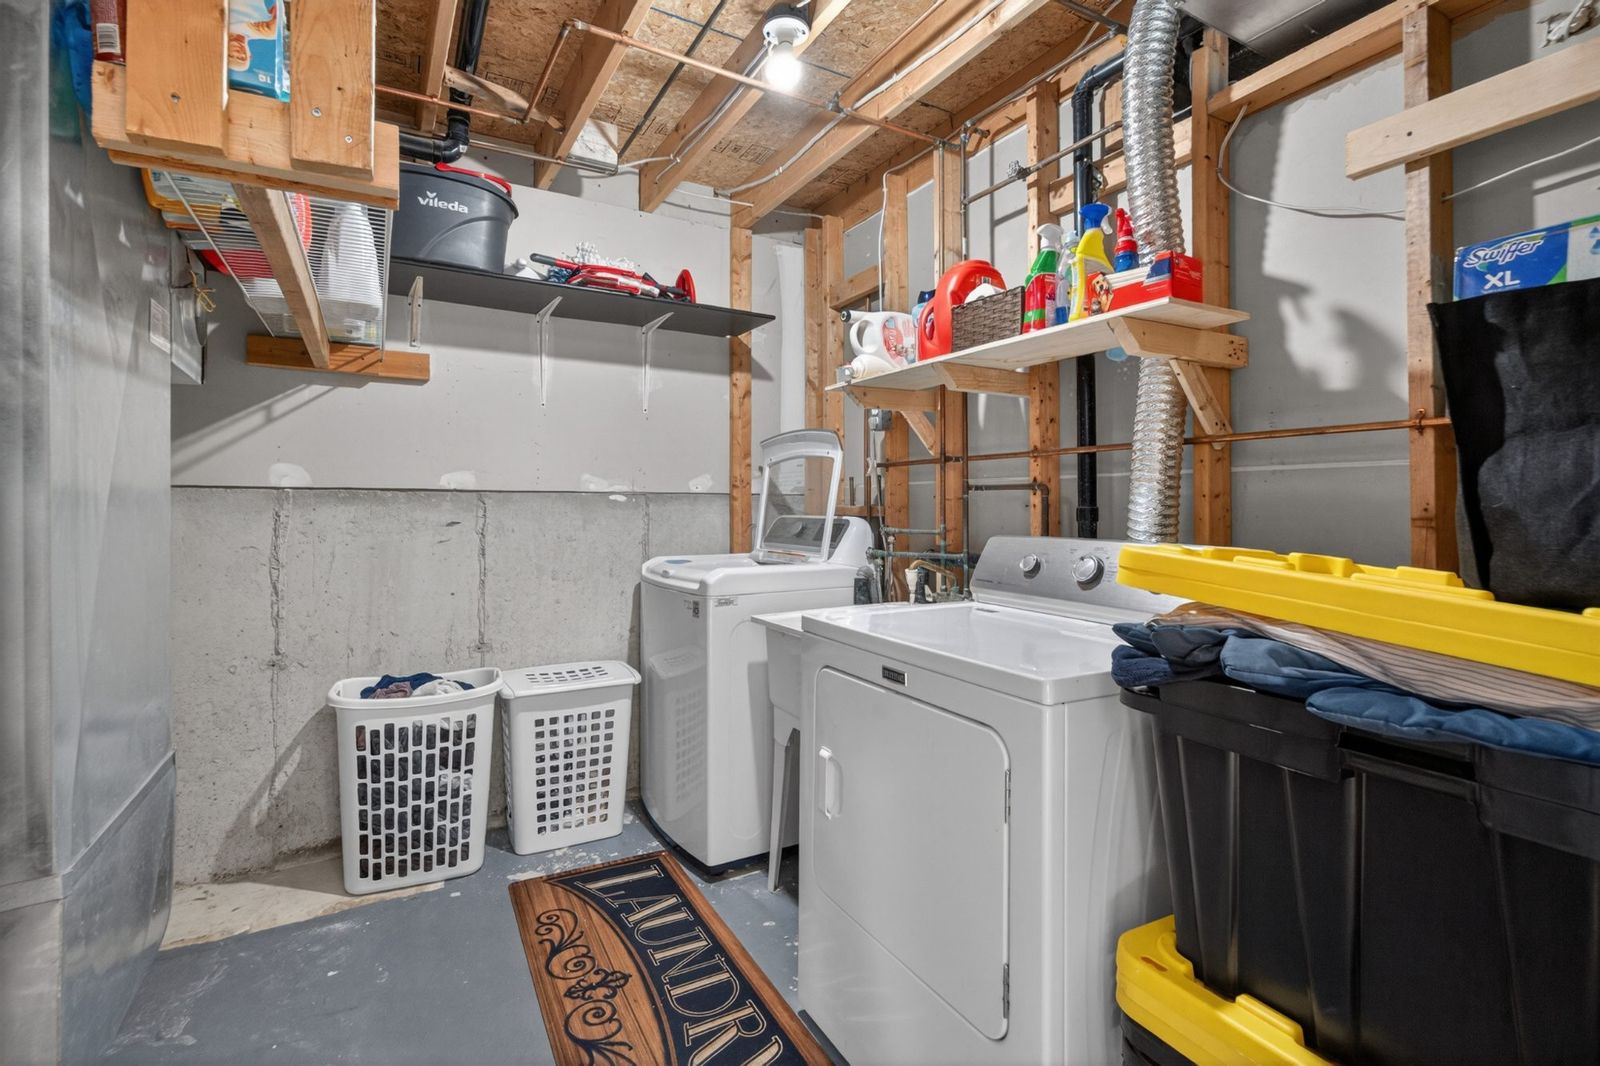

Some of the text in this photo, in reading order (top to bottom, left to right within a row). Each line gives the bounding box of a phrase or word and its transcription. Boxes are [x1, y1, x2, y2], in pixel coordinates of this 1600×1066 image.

[417, 190, 468, 214] vileda
[1463, 239, 1544, 268] Swiffer
[1484, 271, 1520, 290] XL
